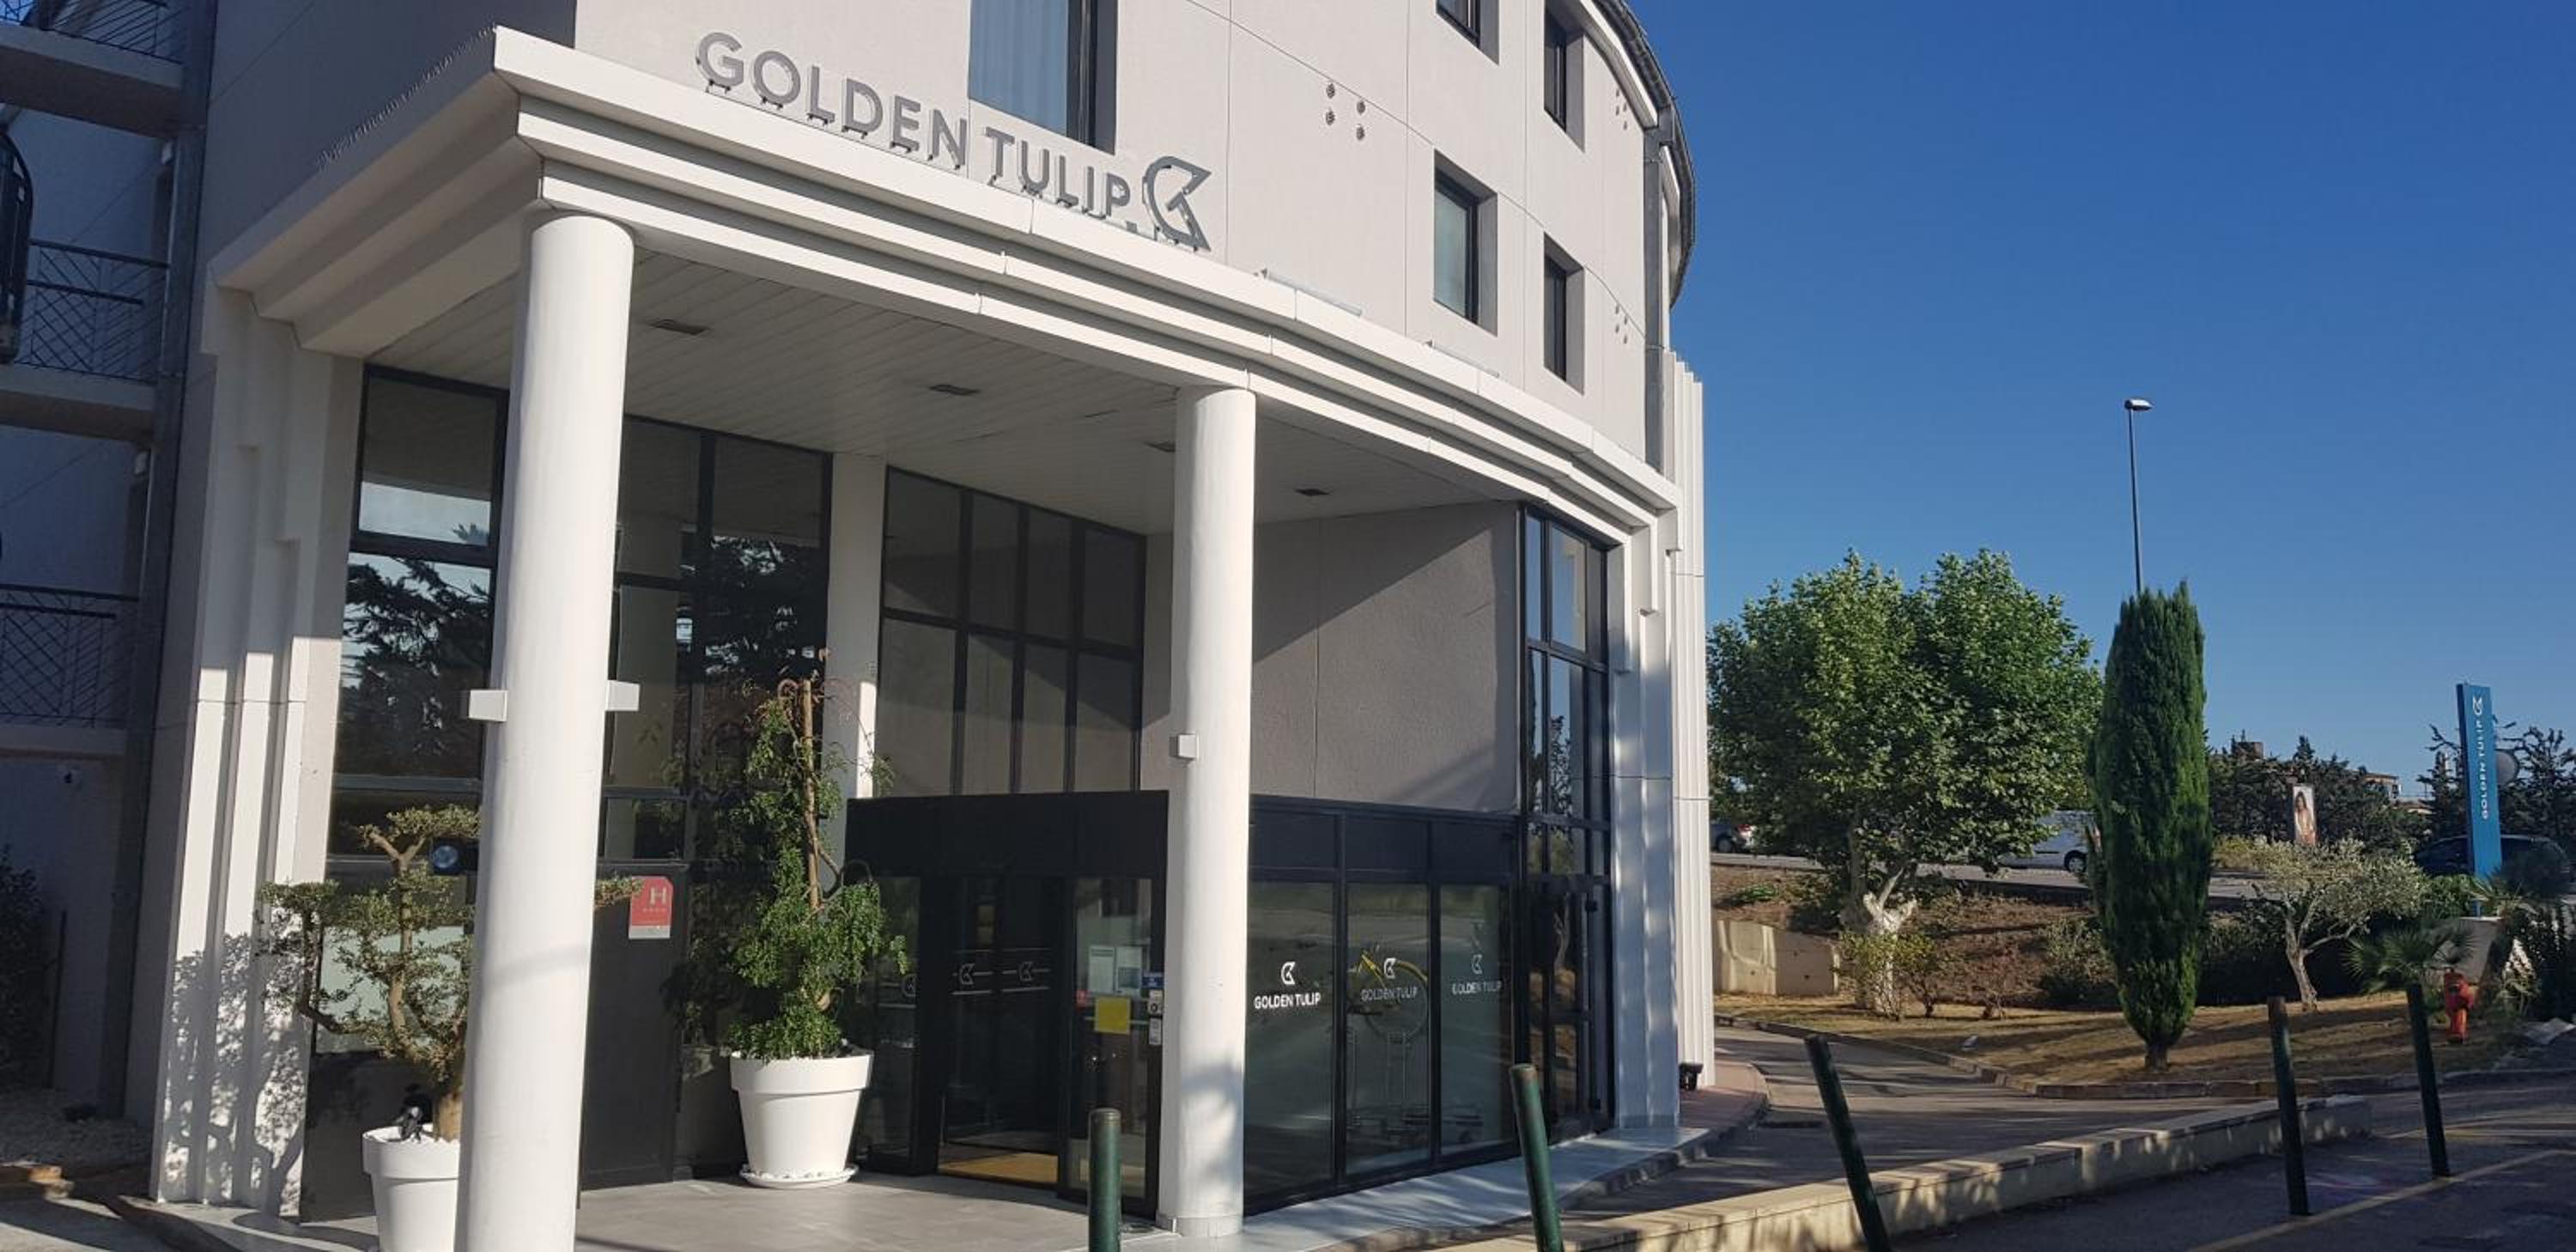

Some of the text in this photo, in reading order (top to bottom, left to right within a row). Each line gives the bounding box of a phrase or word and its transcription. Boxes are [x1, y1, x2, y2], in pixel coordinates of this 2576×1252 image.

[696, 32, 1131, 221] GOLDEN TULIP
[2479, 762, 2489, 820] GOLDEN
[649, 886, 668, 905] H
[1254, 992, 1321, 1009] GOLDEN TULIP
